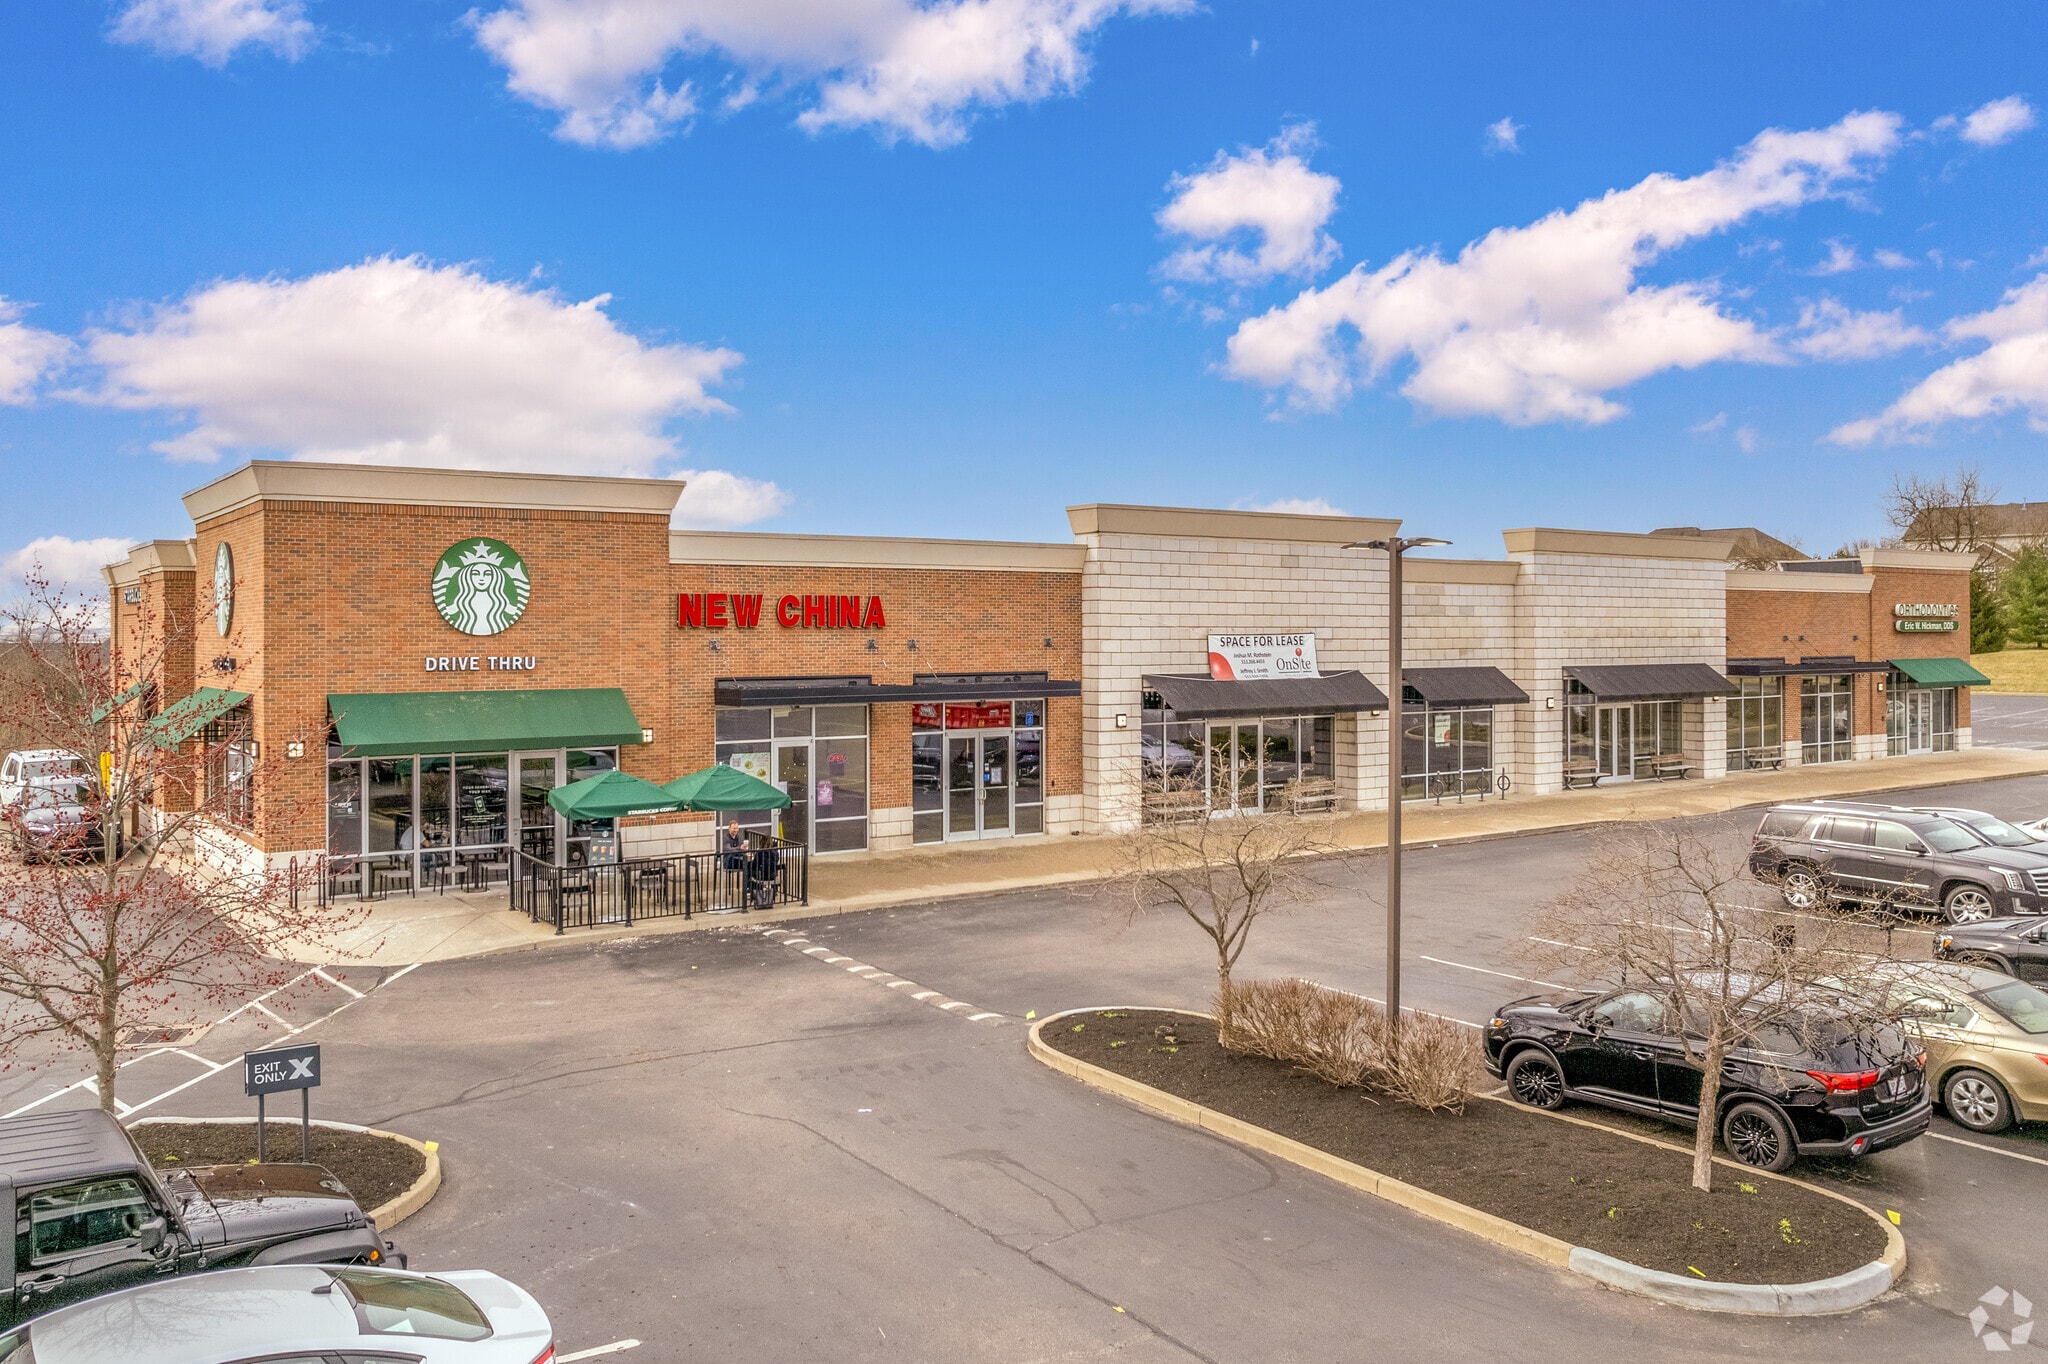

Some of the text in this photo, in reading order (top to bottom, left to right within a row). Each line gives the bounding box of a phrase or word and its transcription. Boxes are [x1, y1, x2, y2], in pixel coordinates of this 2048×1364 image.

[678, 593, 886, 628] NEW CHINA
[1898, 604, 1959, 616] ORTHODONTICS
[1904, 622, 1915, 630] Eric
[1922, 622, 1943, 631] Hickman,
[1943, 622, 1954, 630] DDS
[1220, 635, 1304, 647] SPACE FOR LEASE
[425, 656, 536, 672] DRIVE THRU
[628, 808, 659, 816] STARBUCKS
[254, 1061, 280, 1074] EXIT
[254, 1071, 287, 1084] ONLY
